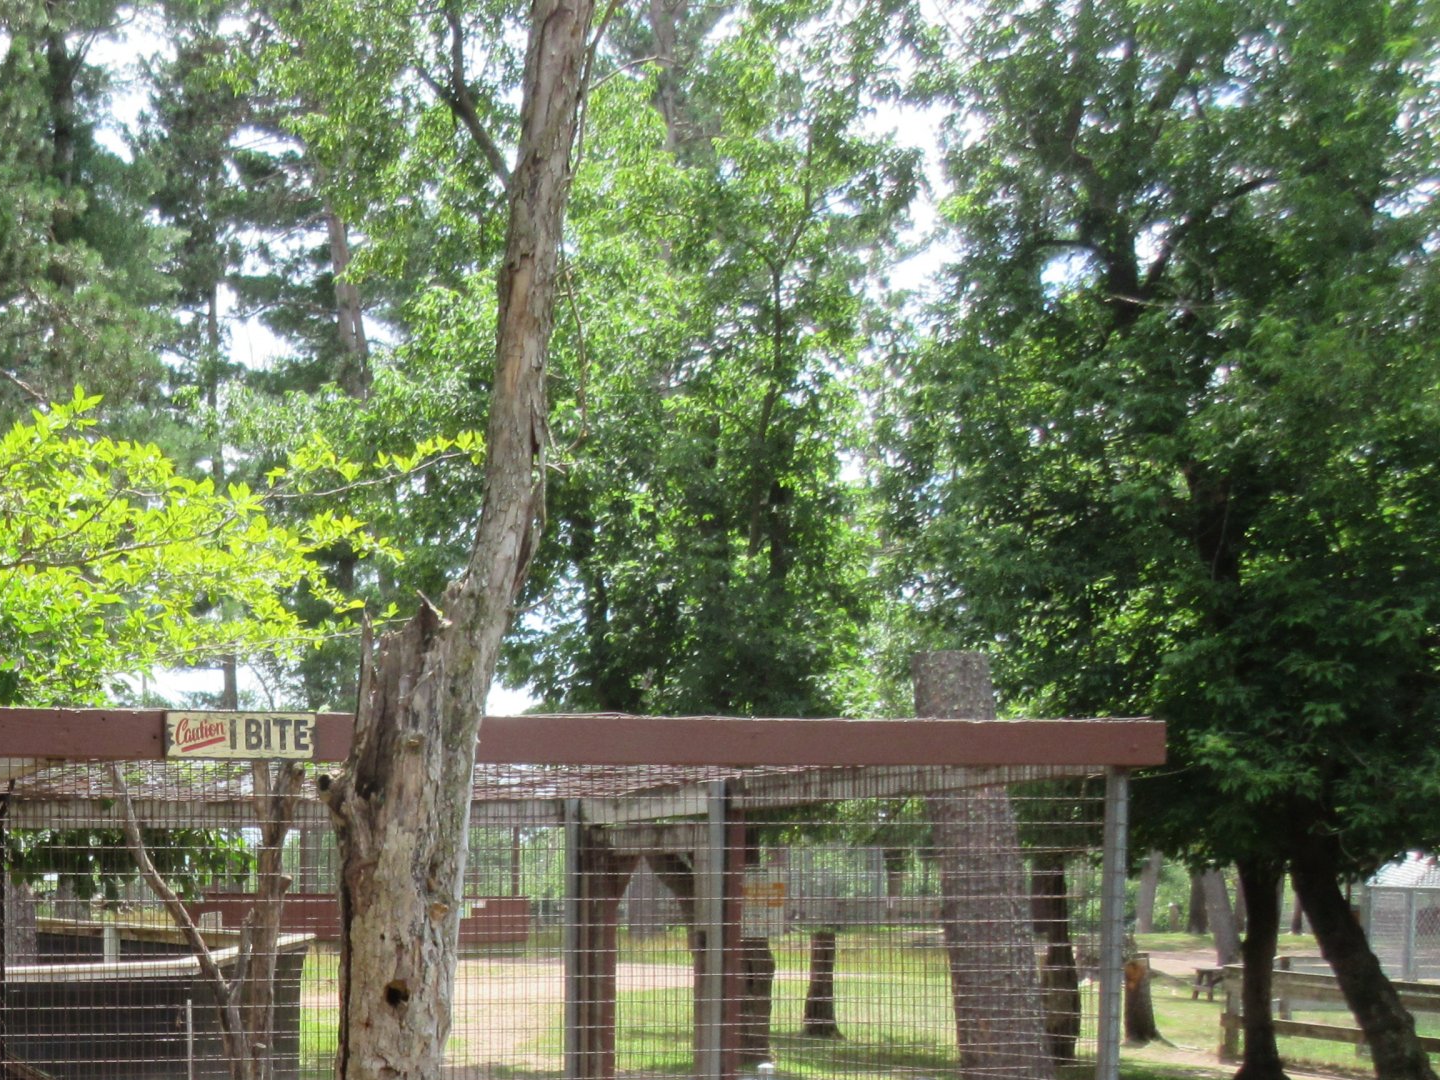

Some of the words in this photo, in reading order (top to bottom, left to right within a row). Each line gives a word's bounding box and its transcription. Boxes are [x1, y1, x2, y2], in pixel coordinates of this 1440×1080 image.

[176, 717, 224, 746] Caution
[229, 719, 237, 750] I
[244, 718, 310, 751] BITE
